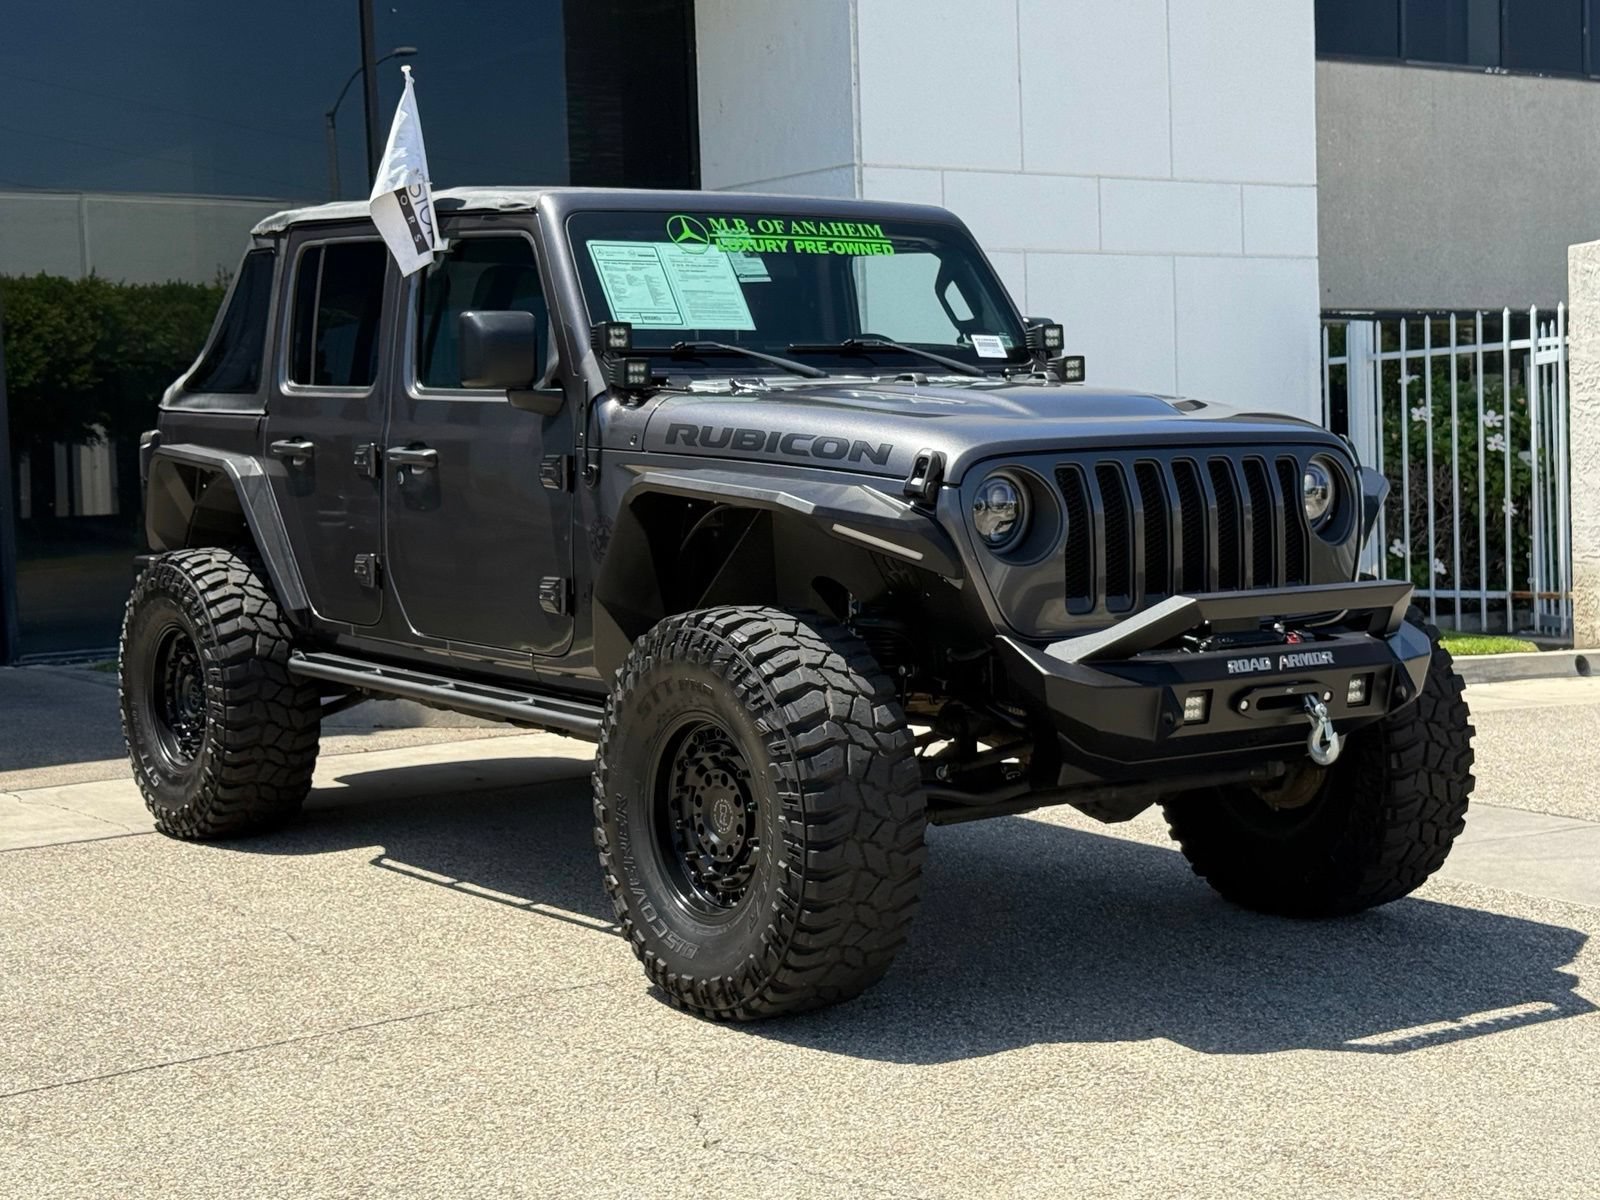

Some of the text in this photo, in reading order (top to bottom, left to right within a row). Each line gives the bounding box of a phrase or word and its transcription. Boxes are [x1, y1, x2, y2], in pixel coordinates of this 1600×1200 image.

[708, 217, 885, 238] M.B. OF ANAHEIM
[717, 239, 894, 256] LUXURY PRE-OWNED
[666, 424, 893, 465] RUBICON
[1227, 651, 1336, 674] ROAD ARMOR
[637, 679, 673, 720] STT
[140, 754, 161, 787] STT
[615, 793, 699, 959] DISCOVERER
